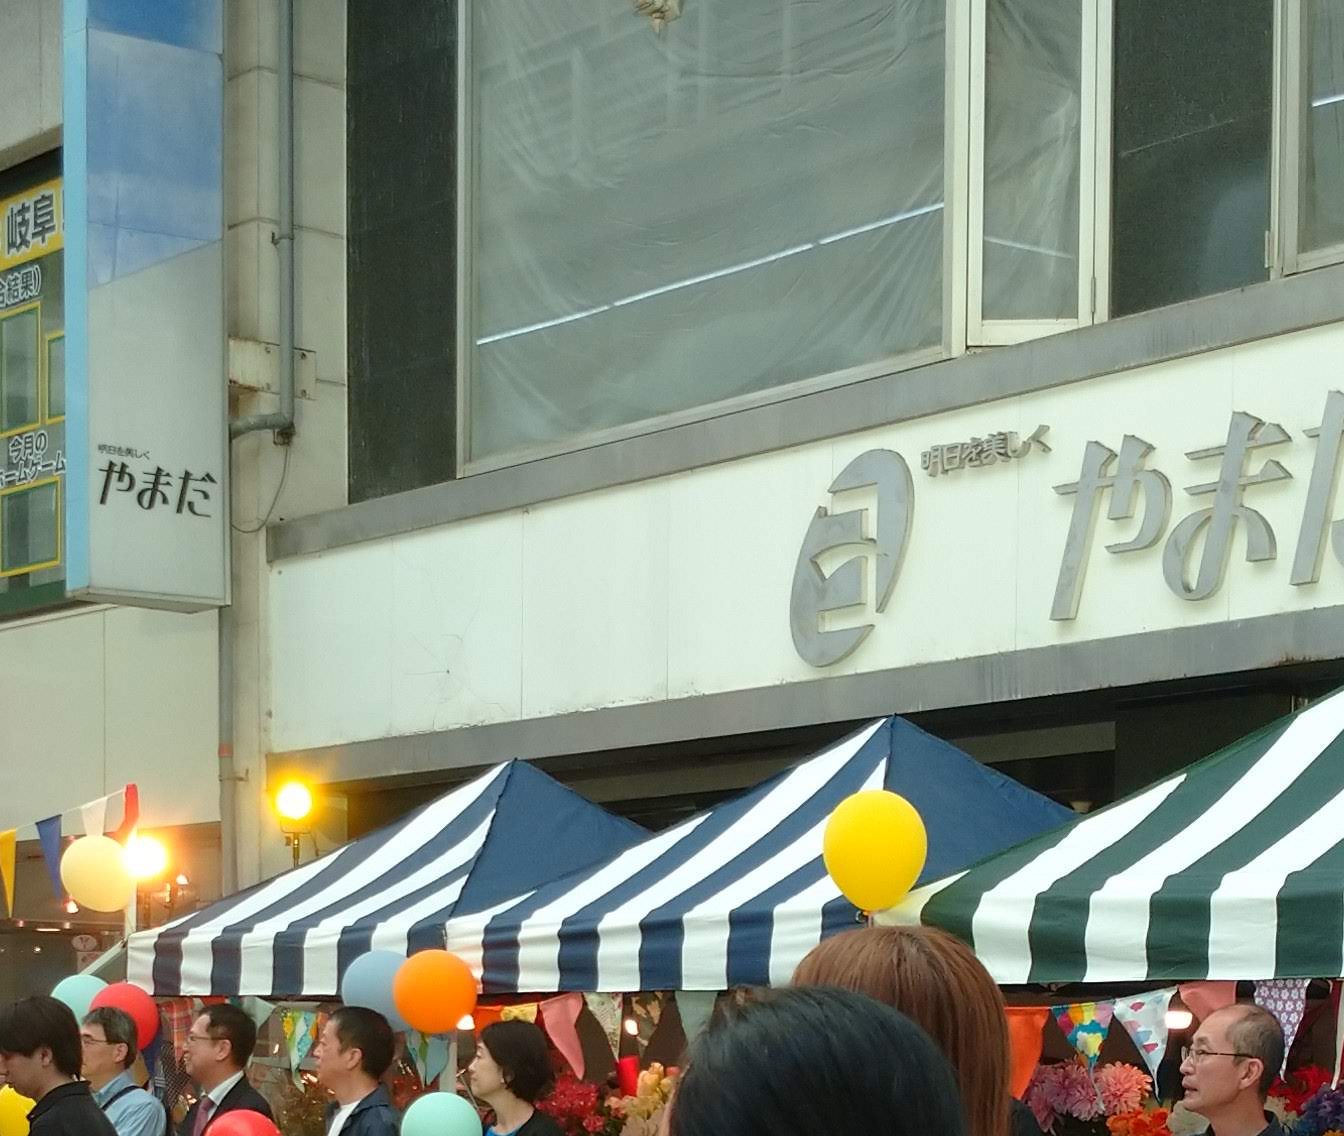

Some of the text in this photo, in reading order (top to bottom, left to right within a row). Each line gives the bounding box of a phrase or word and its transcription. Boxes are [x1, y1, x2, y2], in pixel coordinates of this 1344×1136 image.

[11, 431, 47, 462] 今月の
[921, 424, 1052, 477] 明日を美しく
[98, 460, 218, 518] やまだ
